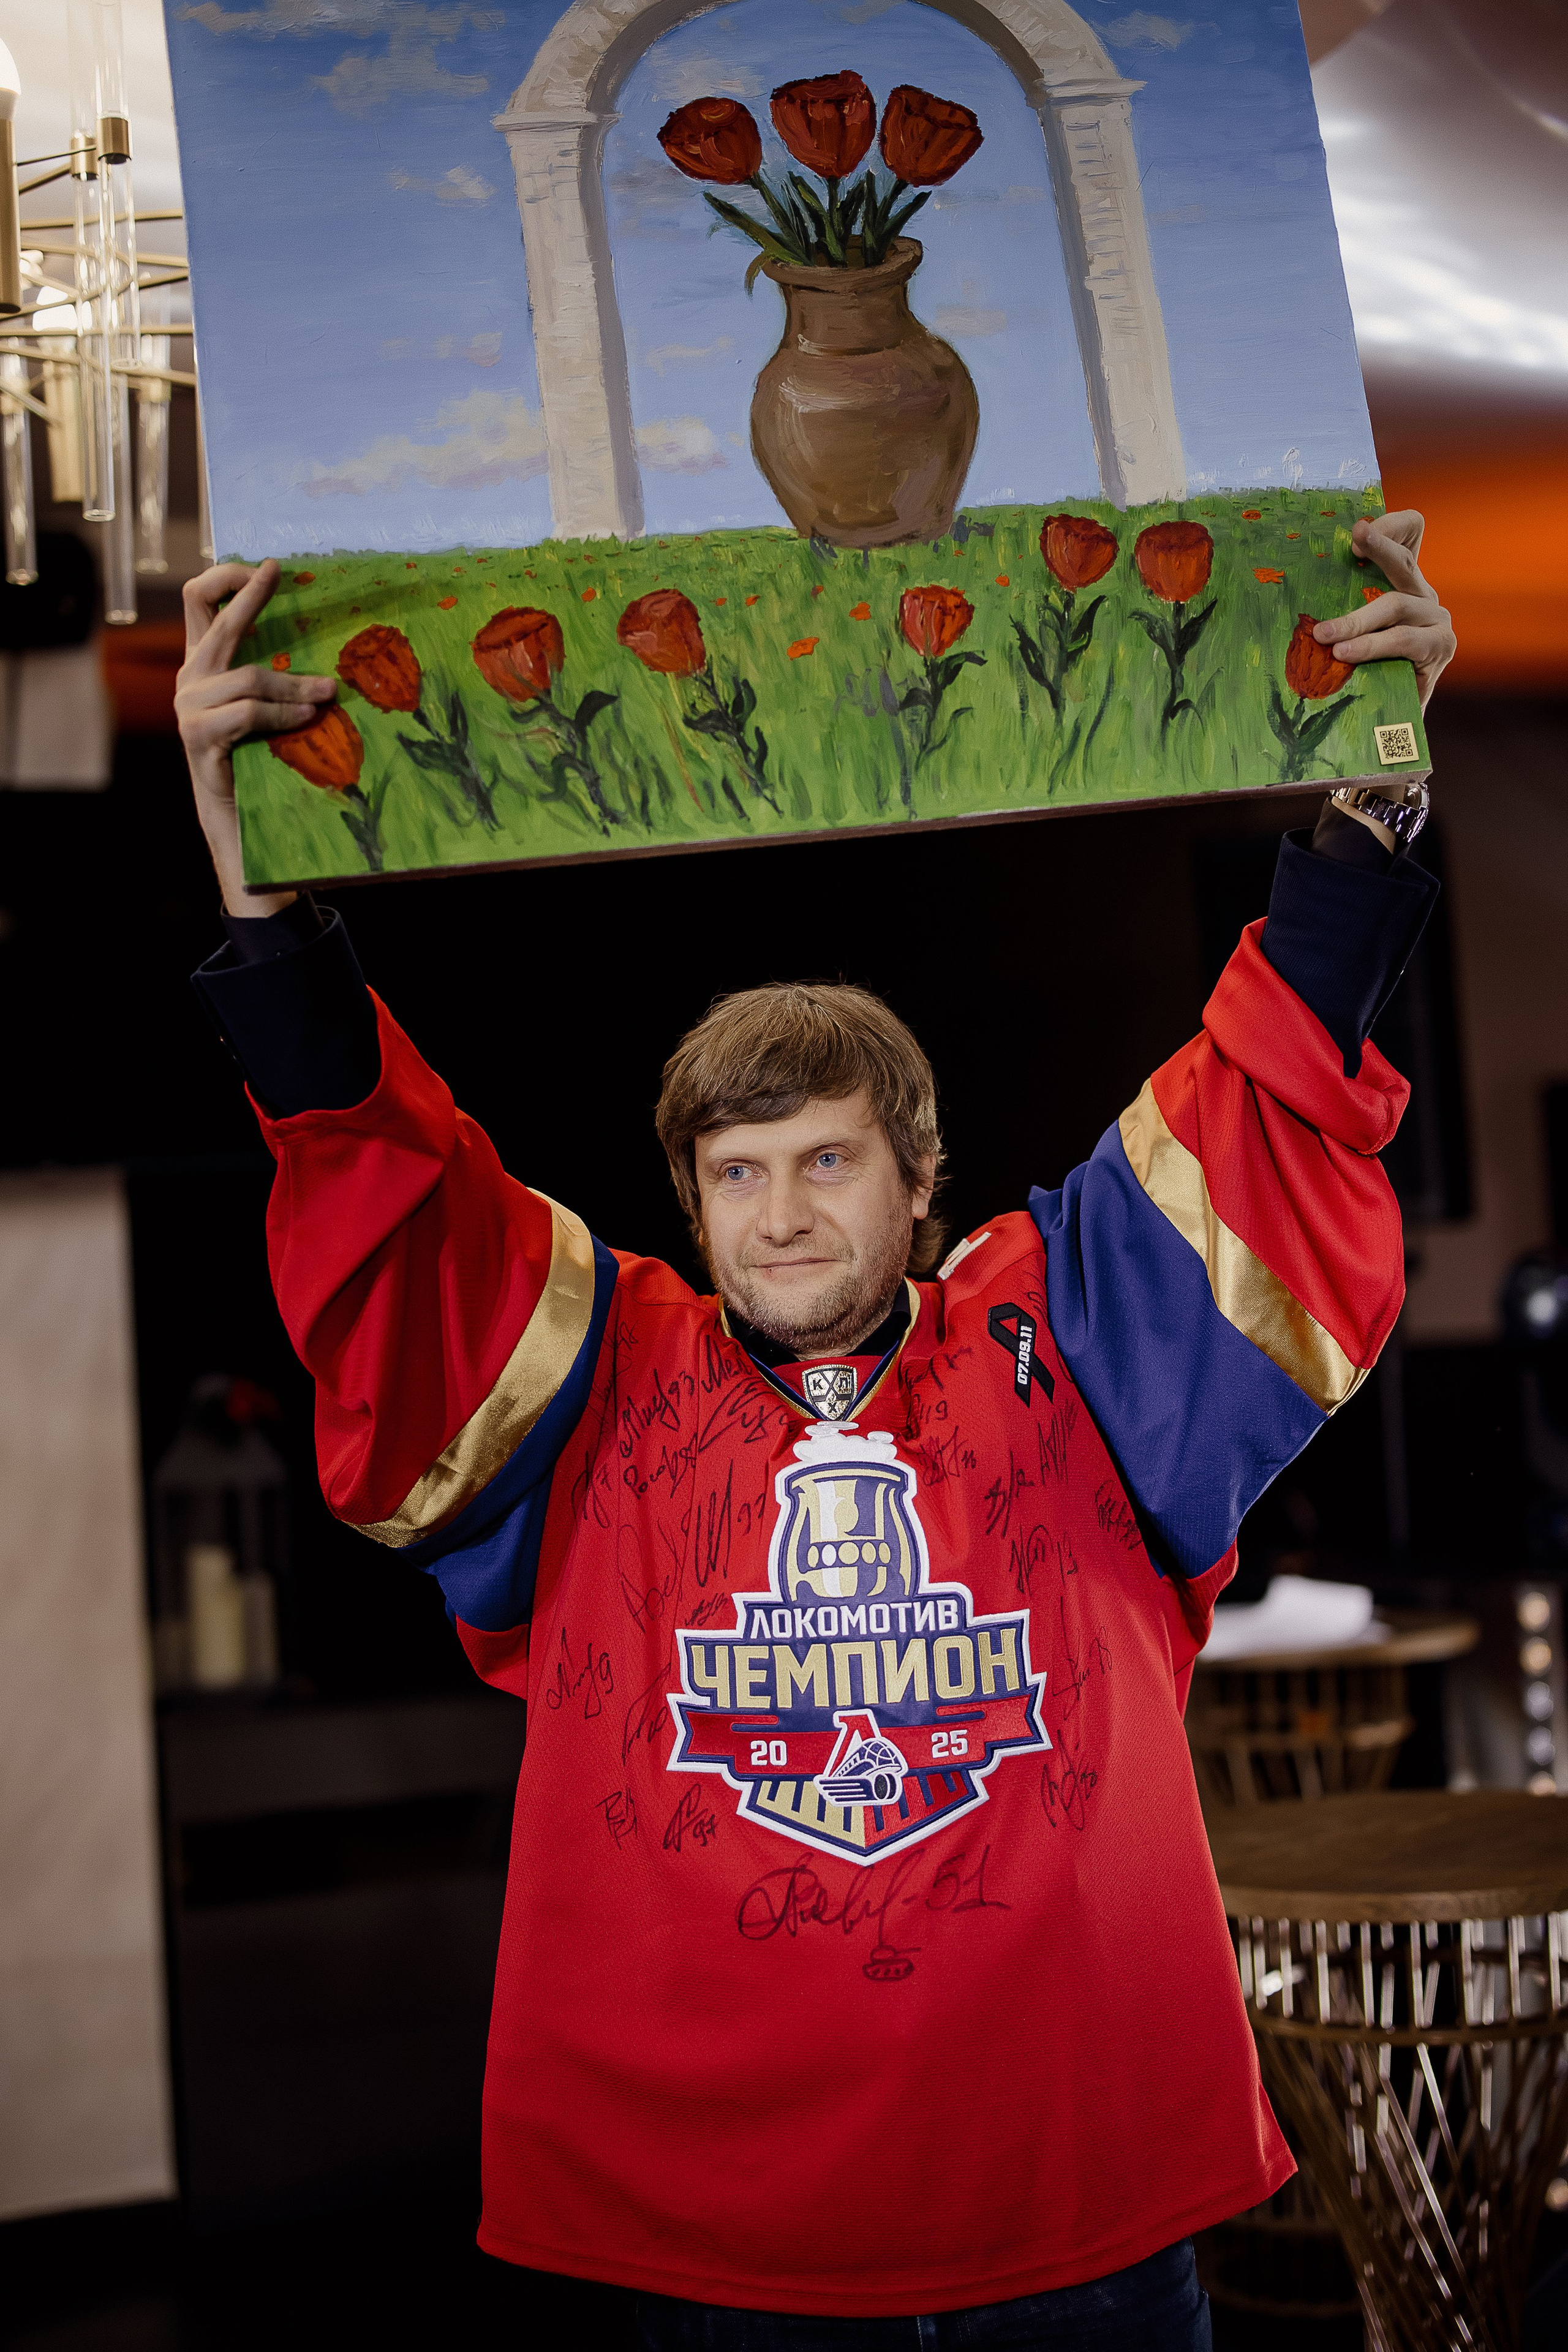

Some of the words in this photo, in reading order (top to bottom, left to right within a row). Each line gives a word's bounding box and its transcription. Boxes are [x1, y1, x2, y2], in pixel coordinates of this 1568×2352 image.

[1017, 1325, 1033, 1385] 07.09.11
[750, 1599, 960, 1640] ЛОКОМОТИВ
[692, 1629, 1020, 1709] ЧЕМПИОН
[750, 1740, 787, 1766] 20
[932, 1728, 968, 1759] 25
